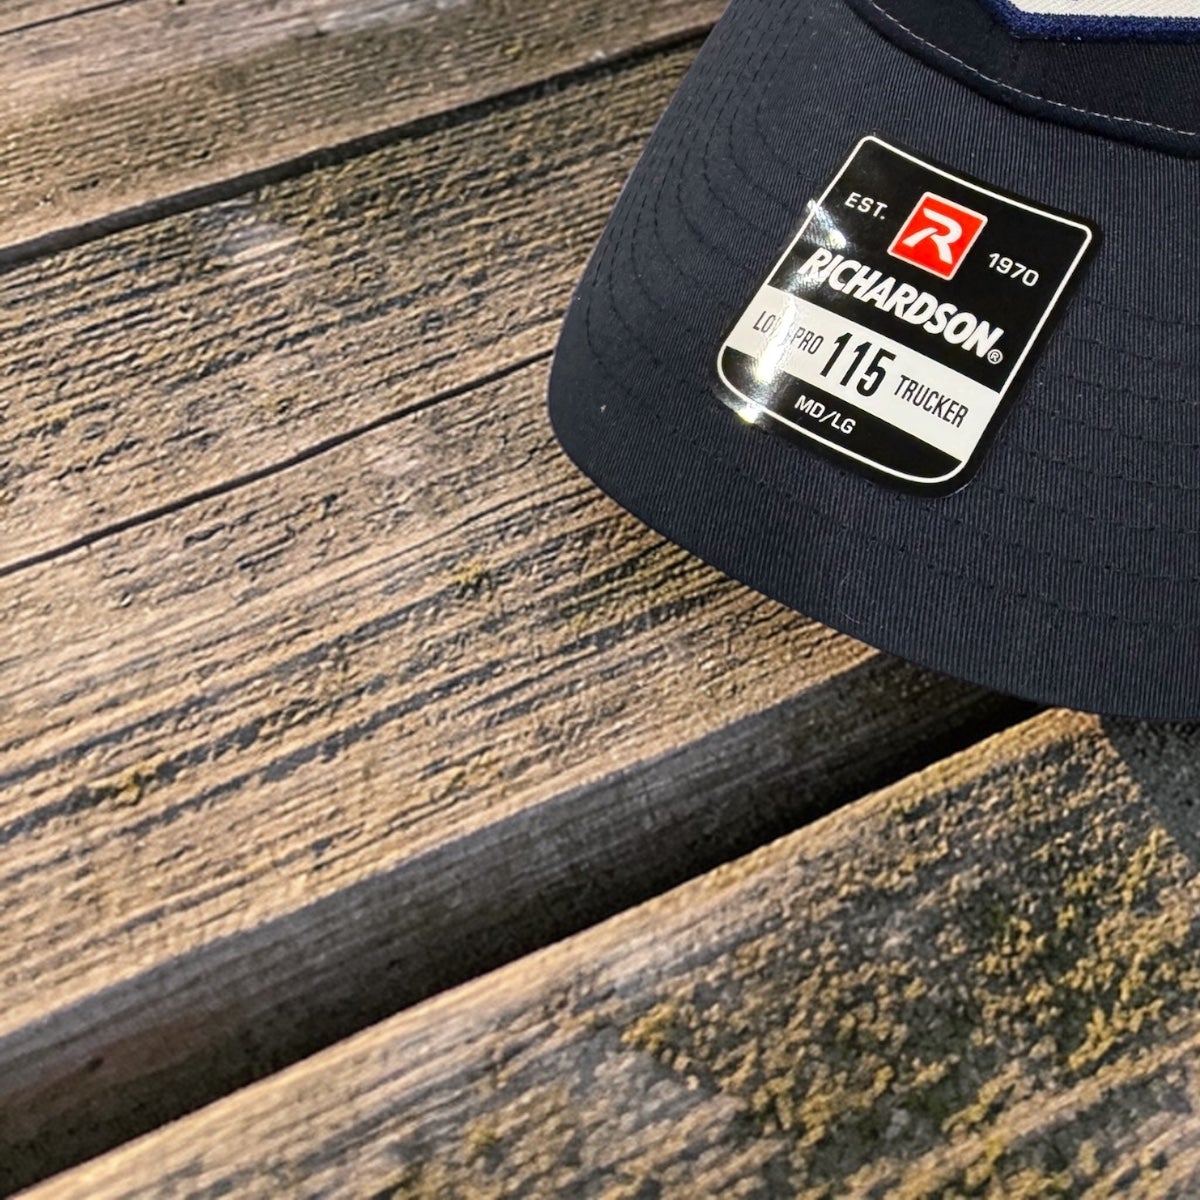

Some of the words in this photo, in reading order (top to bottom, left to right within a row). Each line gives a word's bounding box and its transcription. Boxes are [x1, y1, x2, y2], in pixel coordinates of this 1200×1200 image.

[844, 192, 887, 220] EST.
[988, 252, 1040, 288] 1970
[752, 310, 784, 337] LO
[819, 332, 897, 398] 115
[893, 374, 969, 429] TRUCKER
[794, 394, 857, 435] MD/LG
